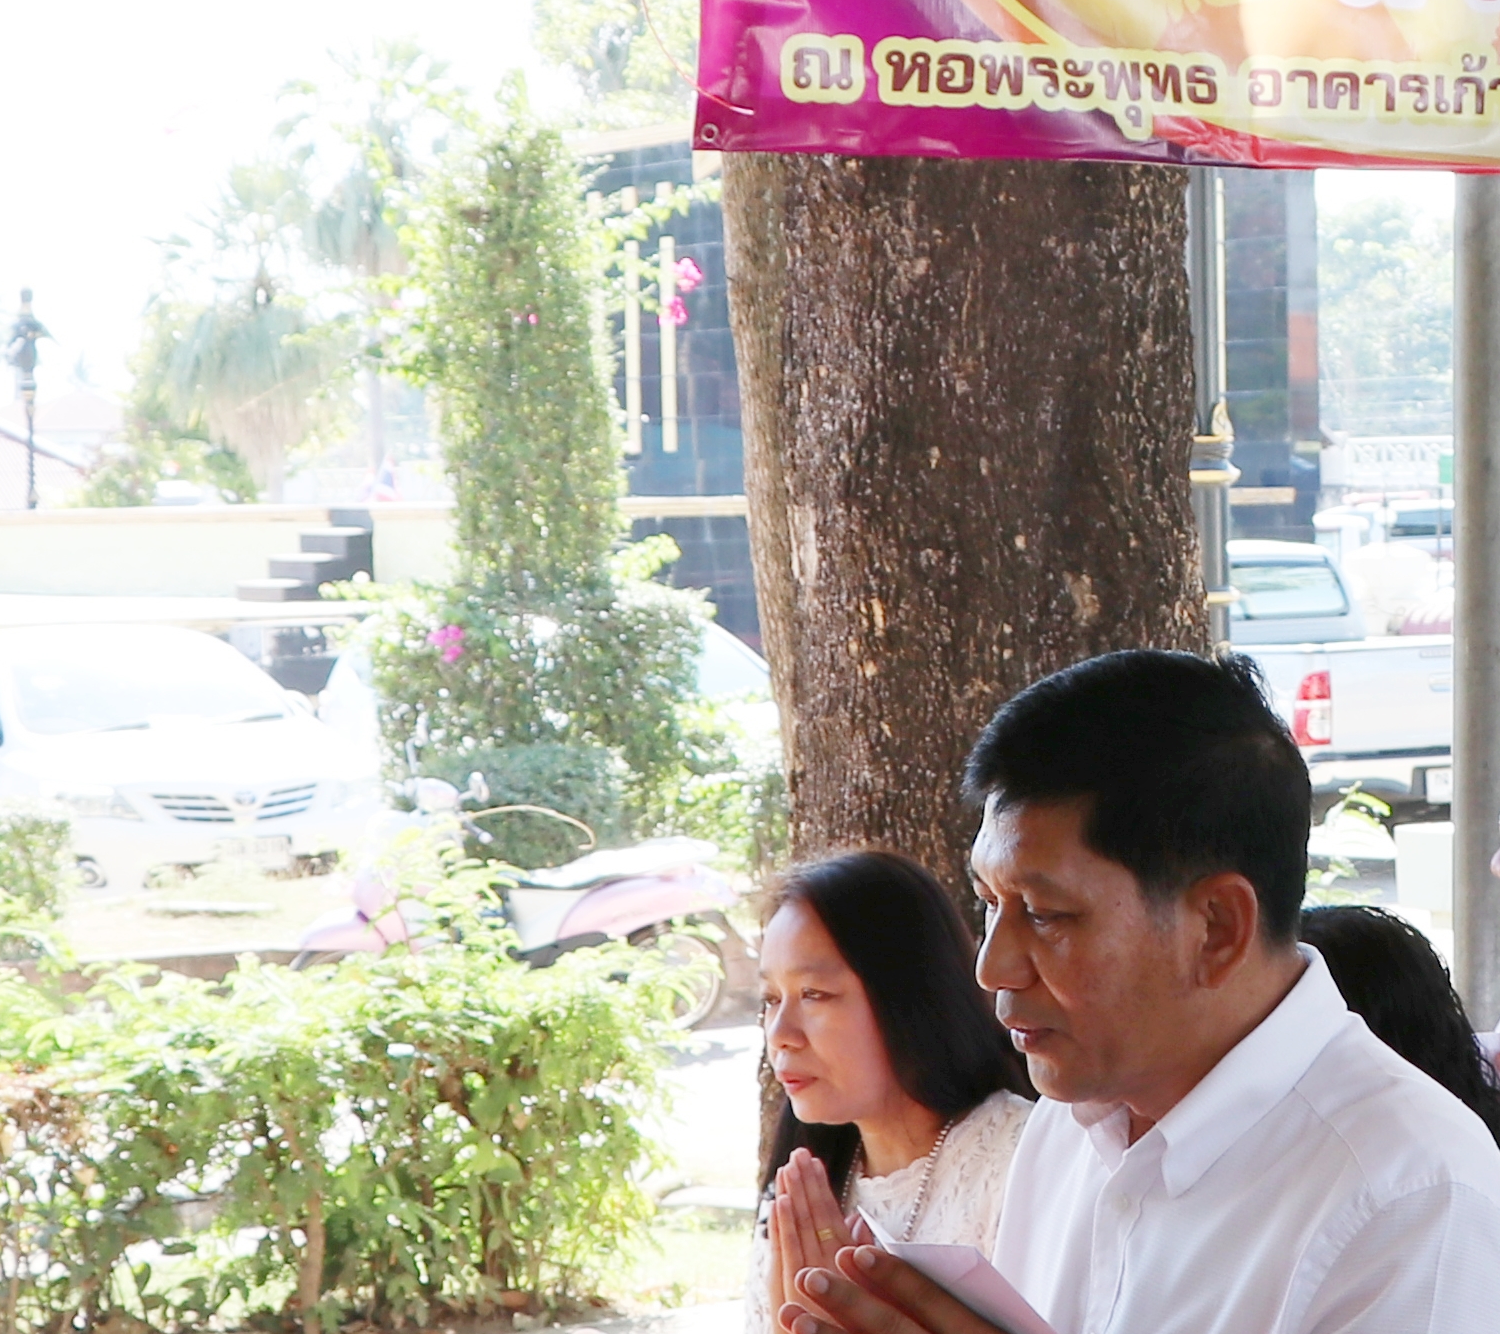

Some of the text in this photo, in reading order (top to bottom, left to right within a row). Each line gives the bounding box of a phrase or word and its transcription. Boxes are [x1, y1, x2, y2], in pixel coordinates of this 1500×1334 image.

[792, 46, 853, 91] ณ
[884, 49, 1219, 129] หอพระพุทธ
